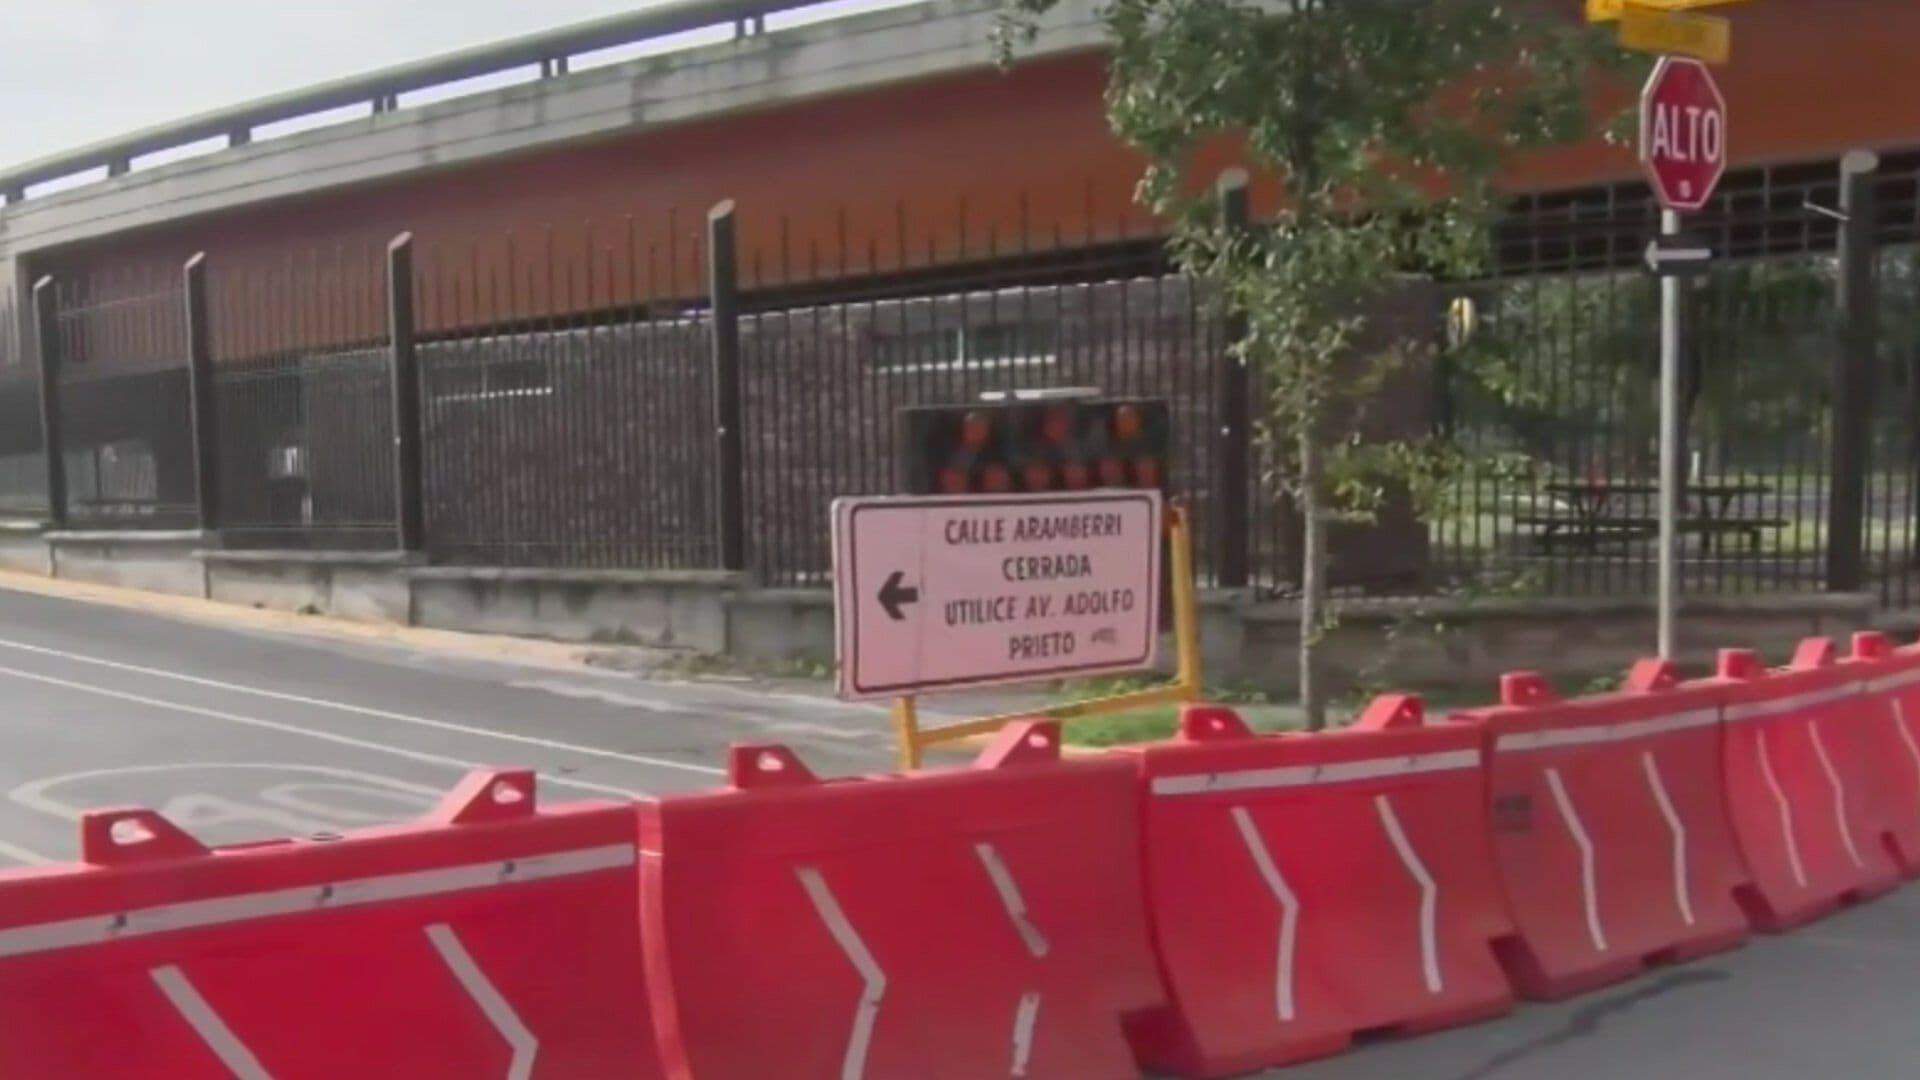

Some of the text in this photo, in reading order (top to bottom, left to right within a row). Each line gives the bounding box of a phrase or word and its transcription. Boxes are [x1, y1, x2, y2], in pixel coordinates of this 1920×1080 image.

[1652, 103, 1721, 163] ALTO
[944, 513, 1122, 545] CALLE ARAMBERRI
[1002, 555, 1092, 582] CERRADA
[944, 589, 1134, 625] UTILICE AV. ADOLFO
[1008, 632, 1075, 660] PRIETO
